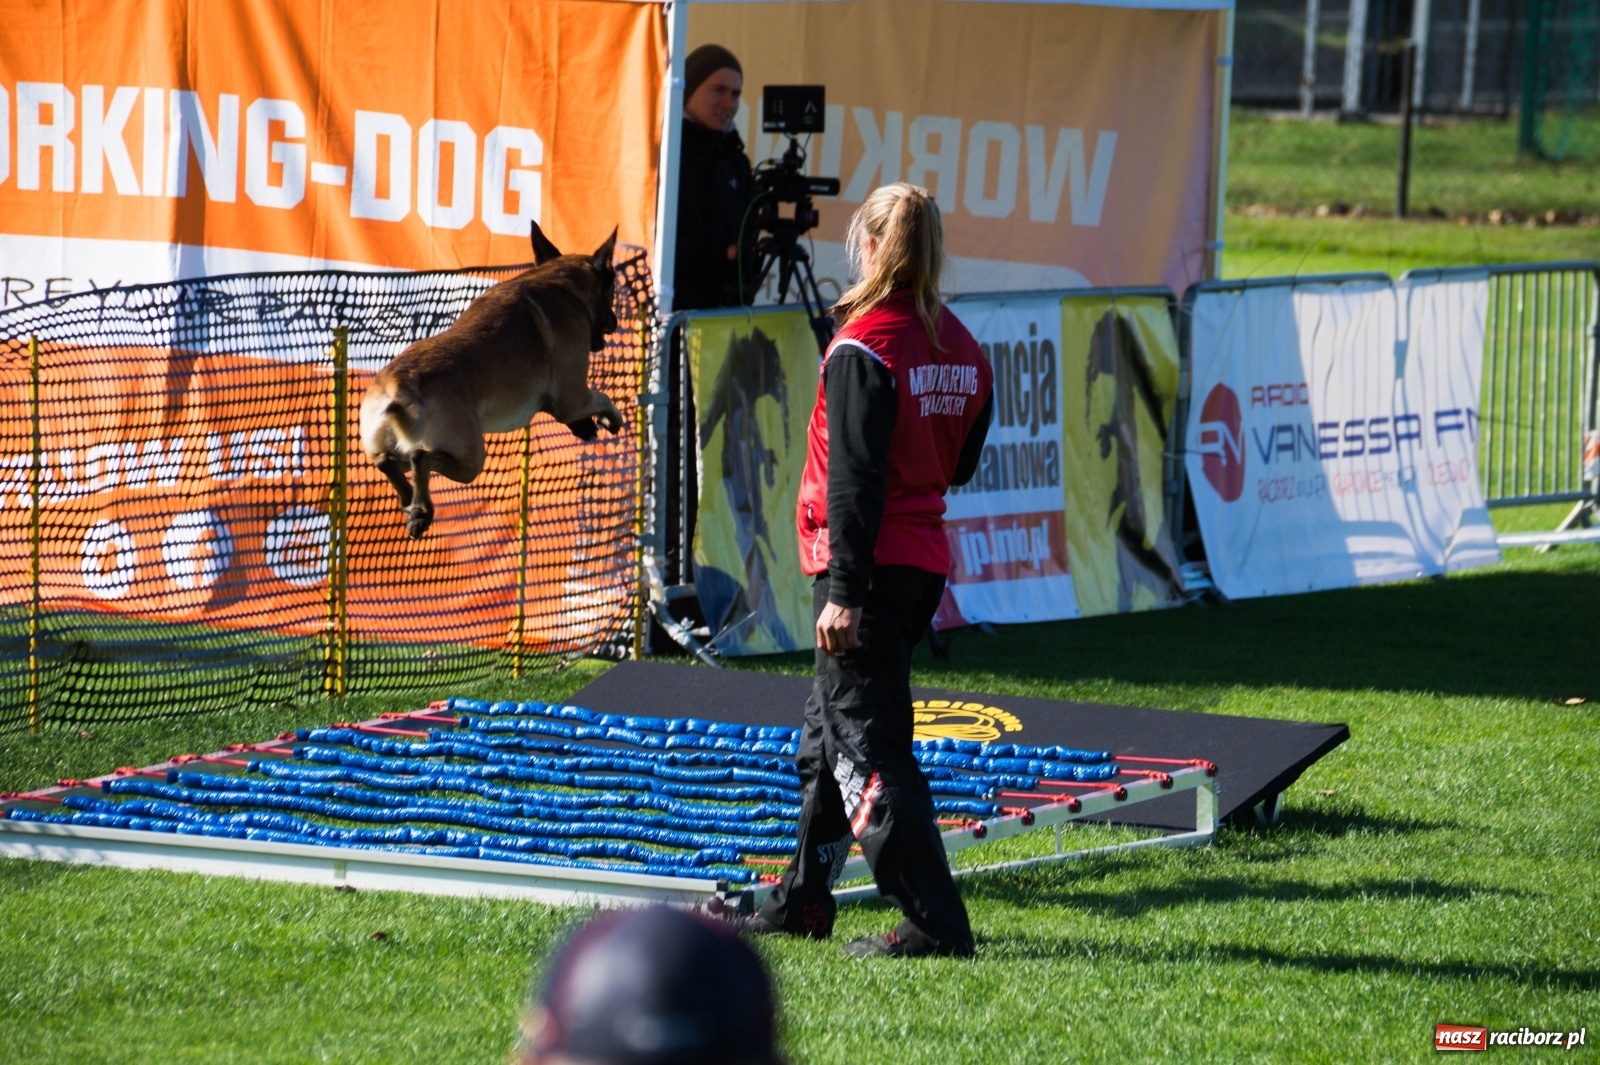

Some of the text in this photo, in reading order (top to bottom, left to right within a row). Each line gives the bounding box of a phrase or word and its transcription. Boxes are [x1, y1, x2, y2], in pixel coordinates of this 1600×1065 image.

[0, 81, 543, 236] RKING-DOG
[979, 322, 1058, 437] ncja
[1252, 414, 1422, 465] VANESSA
